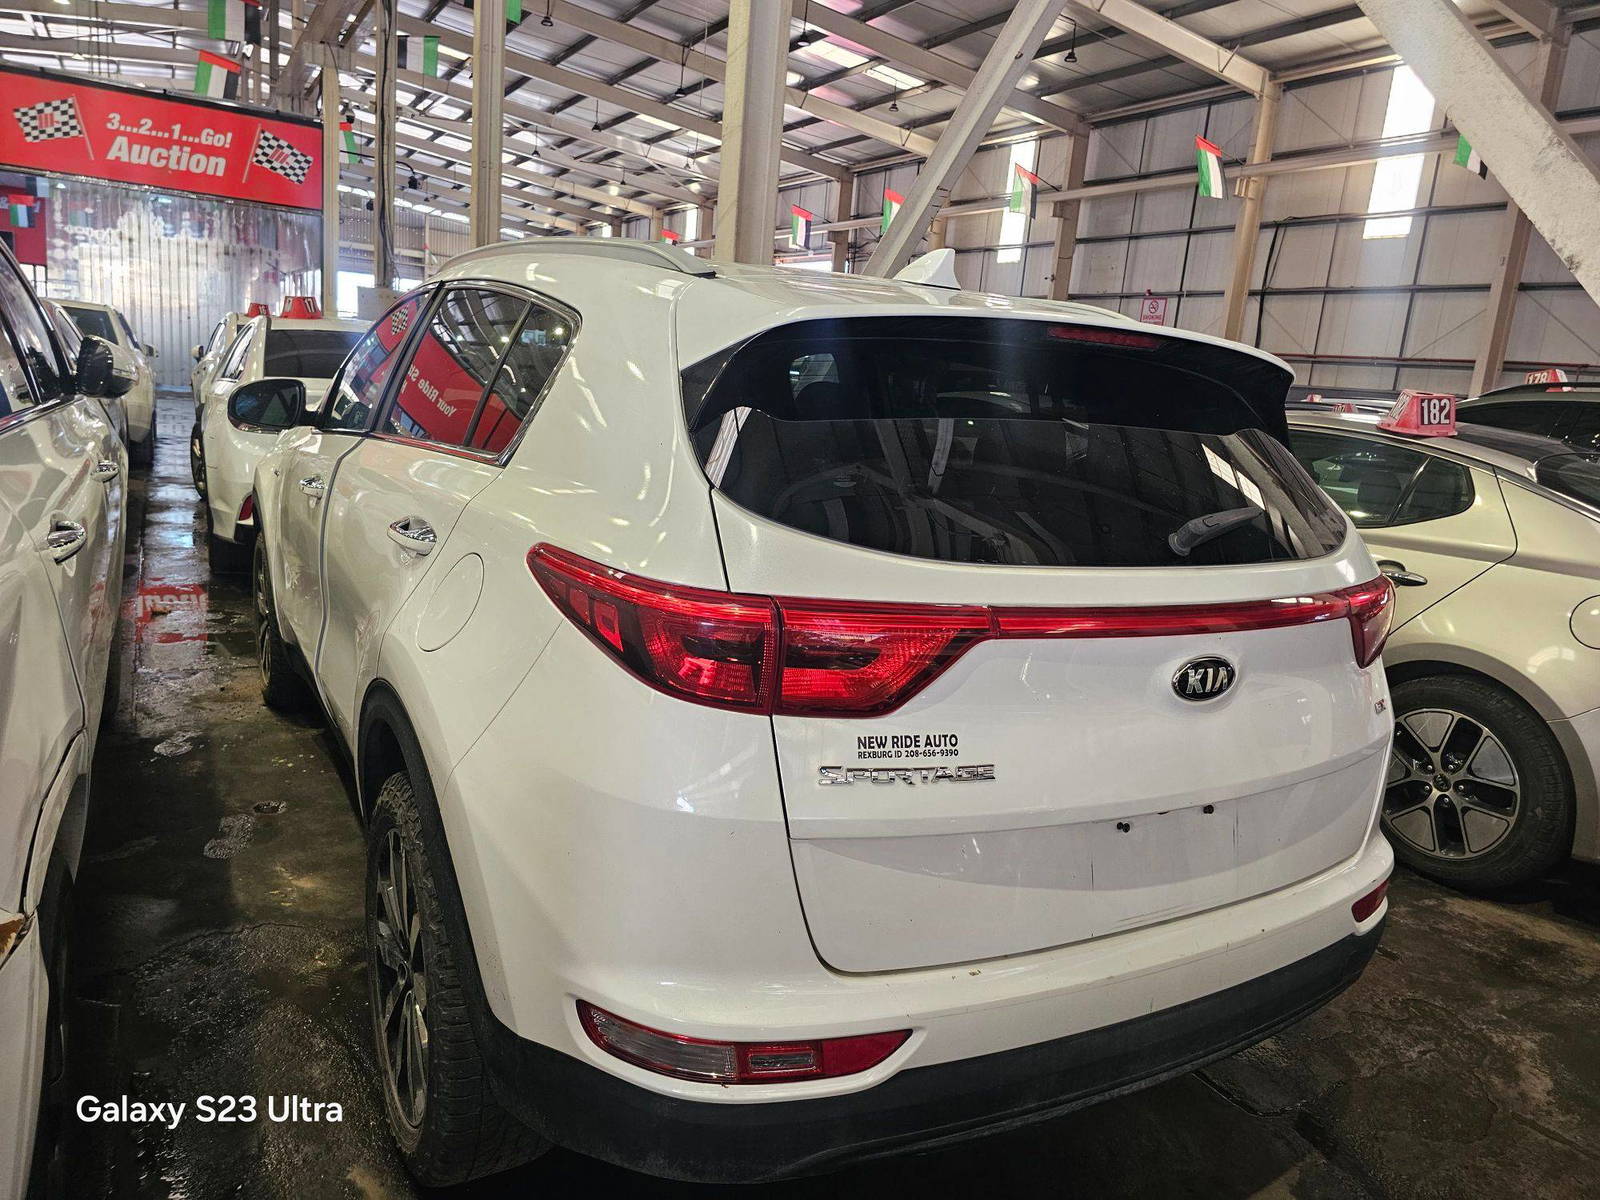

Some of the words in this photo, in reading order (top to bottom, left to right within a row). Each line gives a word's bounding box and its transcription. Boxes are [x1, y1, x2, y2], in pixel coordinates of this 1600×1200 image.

[106, 135, 227, 177] Auction
[1421, 398, 1451, 425] 182
[1186, 666, 1229, 694] KIA
[857, 736, 888, 750] NEW
[891, 735, 921, 749] RIDE
[924, 733, 959, 748] AUTO
[857, 750, 893, 760] REXBURG
[894, 750, 902, 759] ID
[904, 749, 959, 758] 208-656-9390
[819, 764, 996, 786] SPORTAGE
